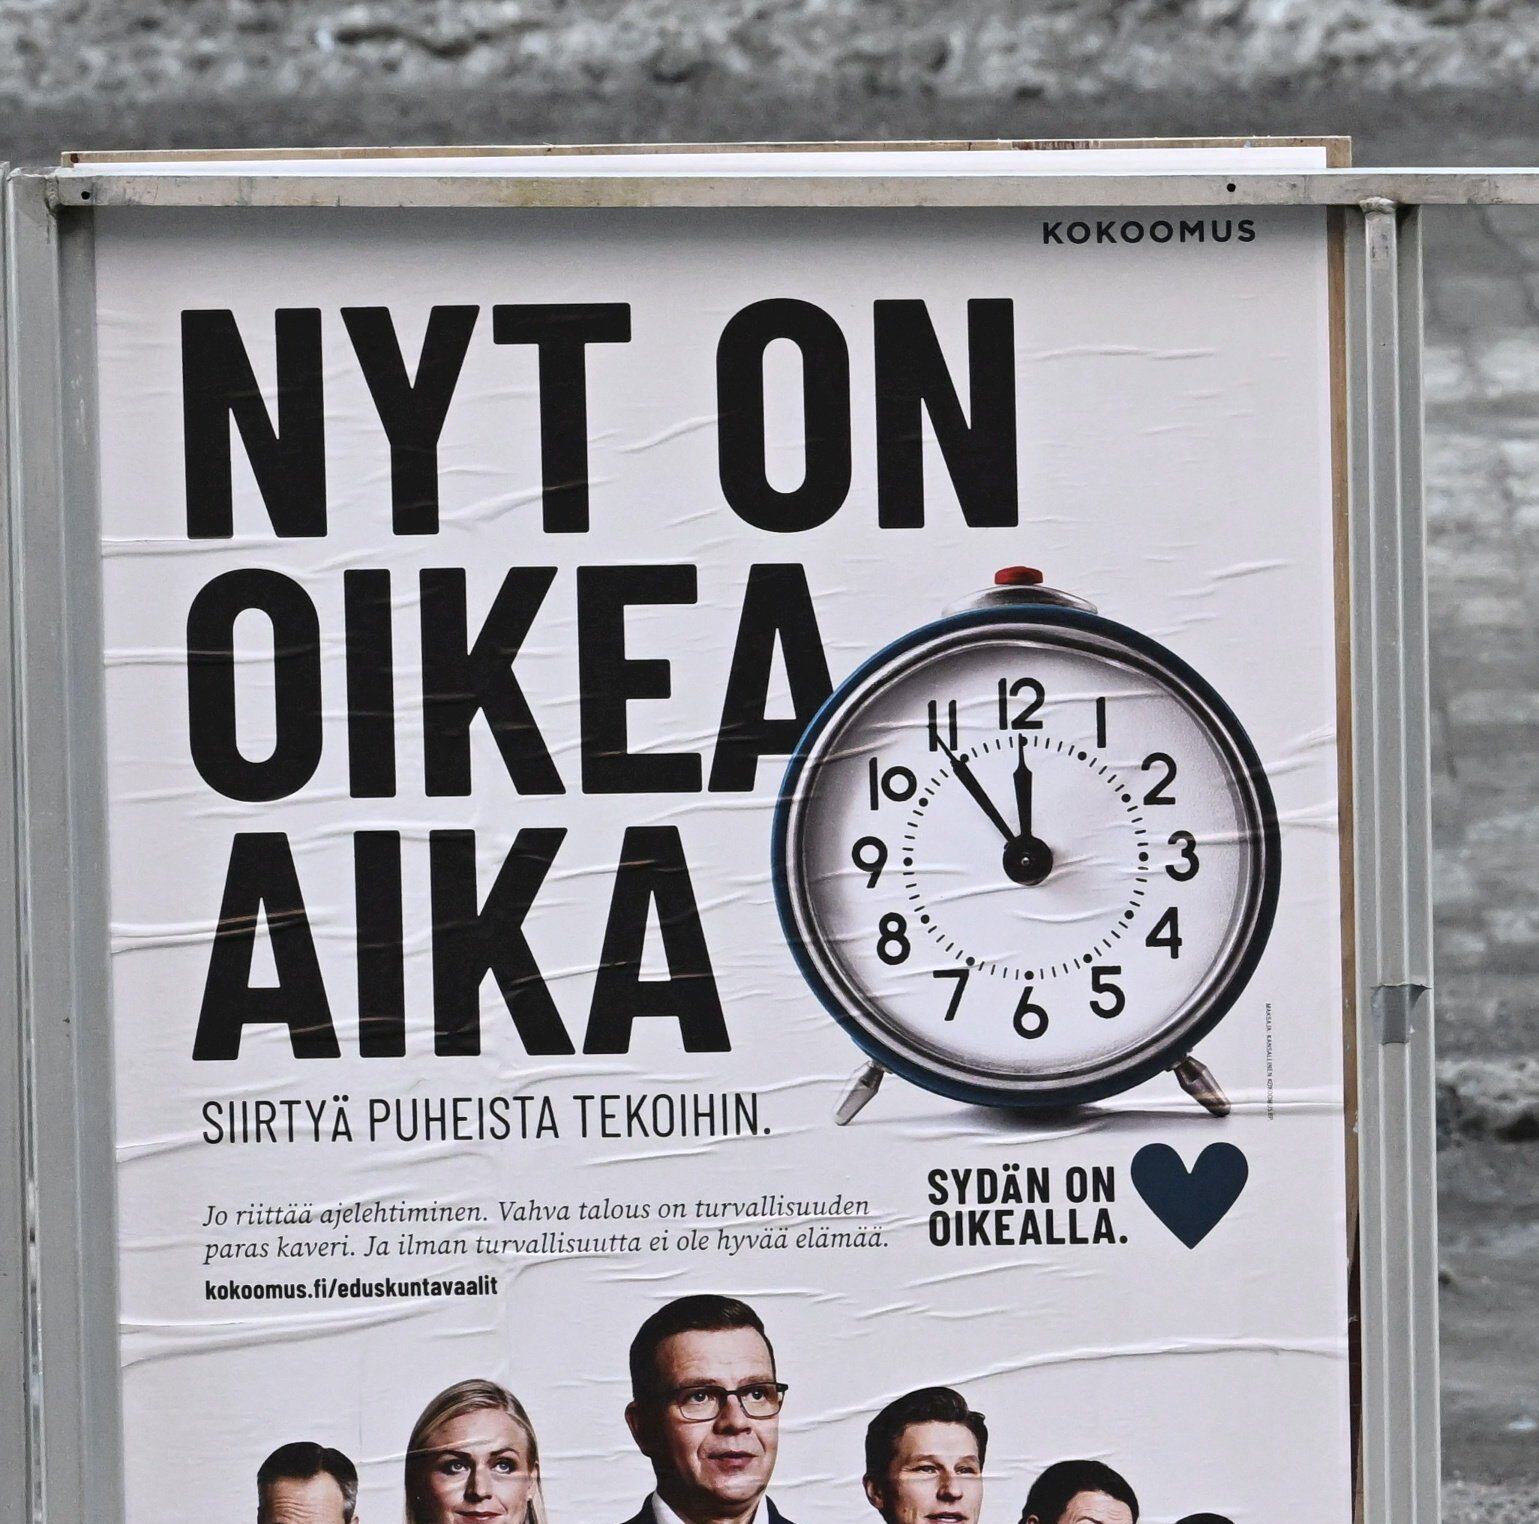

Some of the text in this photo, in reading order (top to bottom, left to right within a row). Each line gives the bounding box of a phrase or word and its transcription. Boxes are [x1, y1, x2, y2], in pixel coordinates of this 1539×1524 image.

[1042, 219, 1256, 244] KOKOOMUS
[181, 297, 1019, 539] NYT ON
[186, 563, 835, 802] OIKEA
[998, 677, 1046, 730] 12
[928, 700, 957, 751] 11
[1096, 697, 1106, 748] 1
[869, 757, 917, 810] 10
[1141, 752, 1177, 805] 2
[851, 836, 888, 888] 9
[1165, 830, 1199, 881] 3
[193, 825, 731, 1060] AIKA
[876, 912, 911, 965] 8
[1145, 907, 1182, 959] 4
[933, 970, 970, 1021] 7
[1013, 986, 1049, 1039] 6
[1089, 966, 1125, 1019] 5
[201, 1093, 772, 1144] SIIRTYÄ PUHEISTA TEKOIHIN.
[928, 1163, 1115, 1205] SYDÄN ON
[202, 1195, 869, 1228] Jo riittää ajelehtiminen. Vahva talous on turvallisuuden
[929, 1208, 1128, 1247] OIKEALLA.
[203, 1224, 888, 1266] paras kaveri. Ja ilman turvallisuutta ei ole hyvää elämää.
[205, 1276, 498, 1301] kokoomus.fi/eduskuntavaalit
